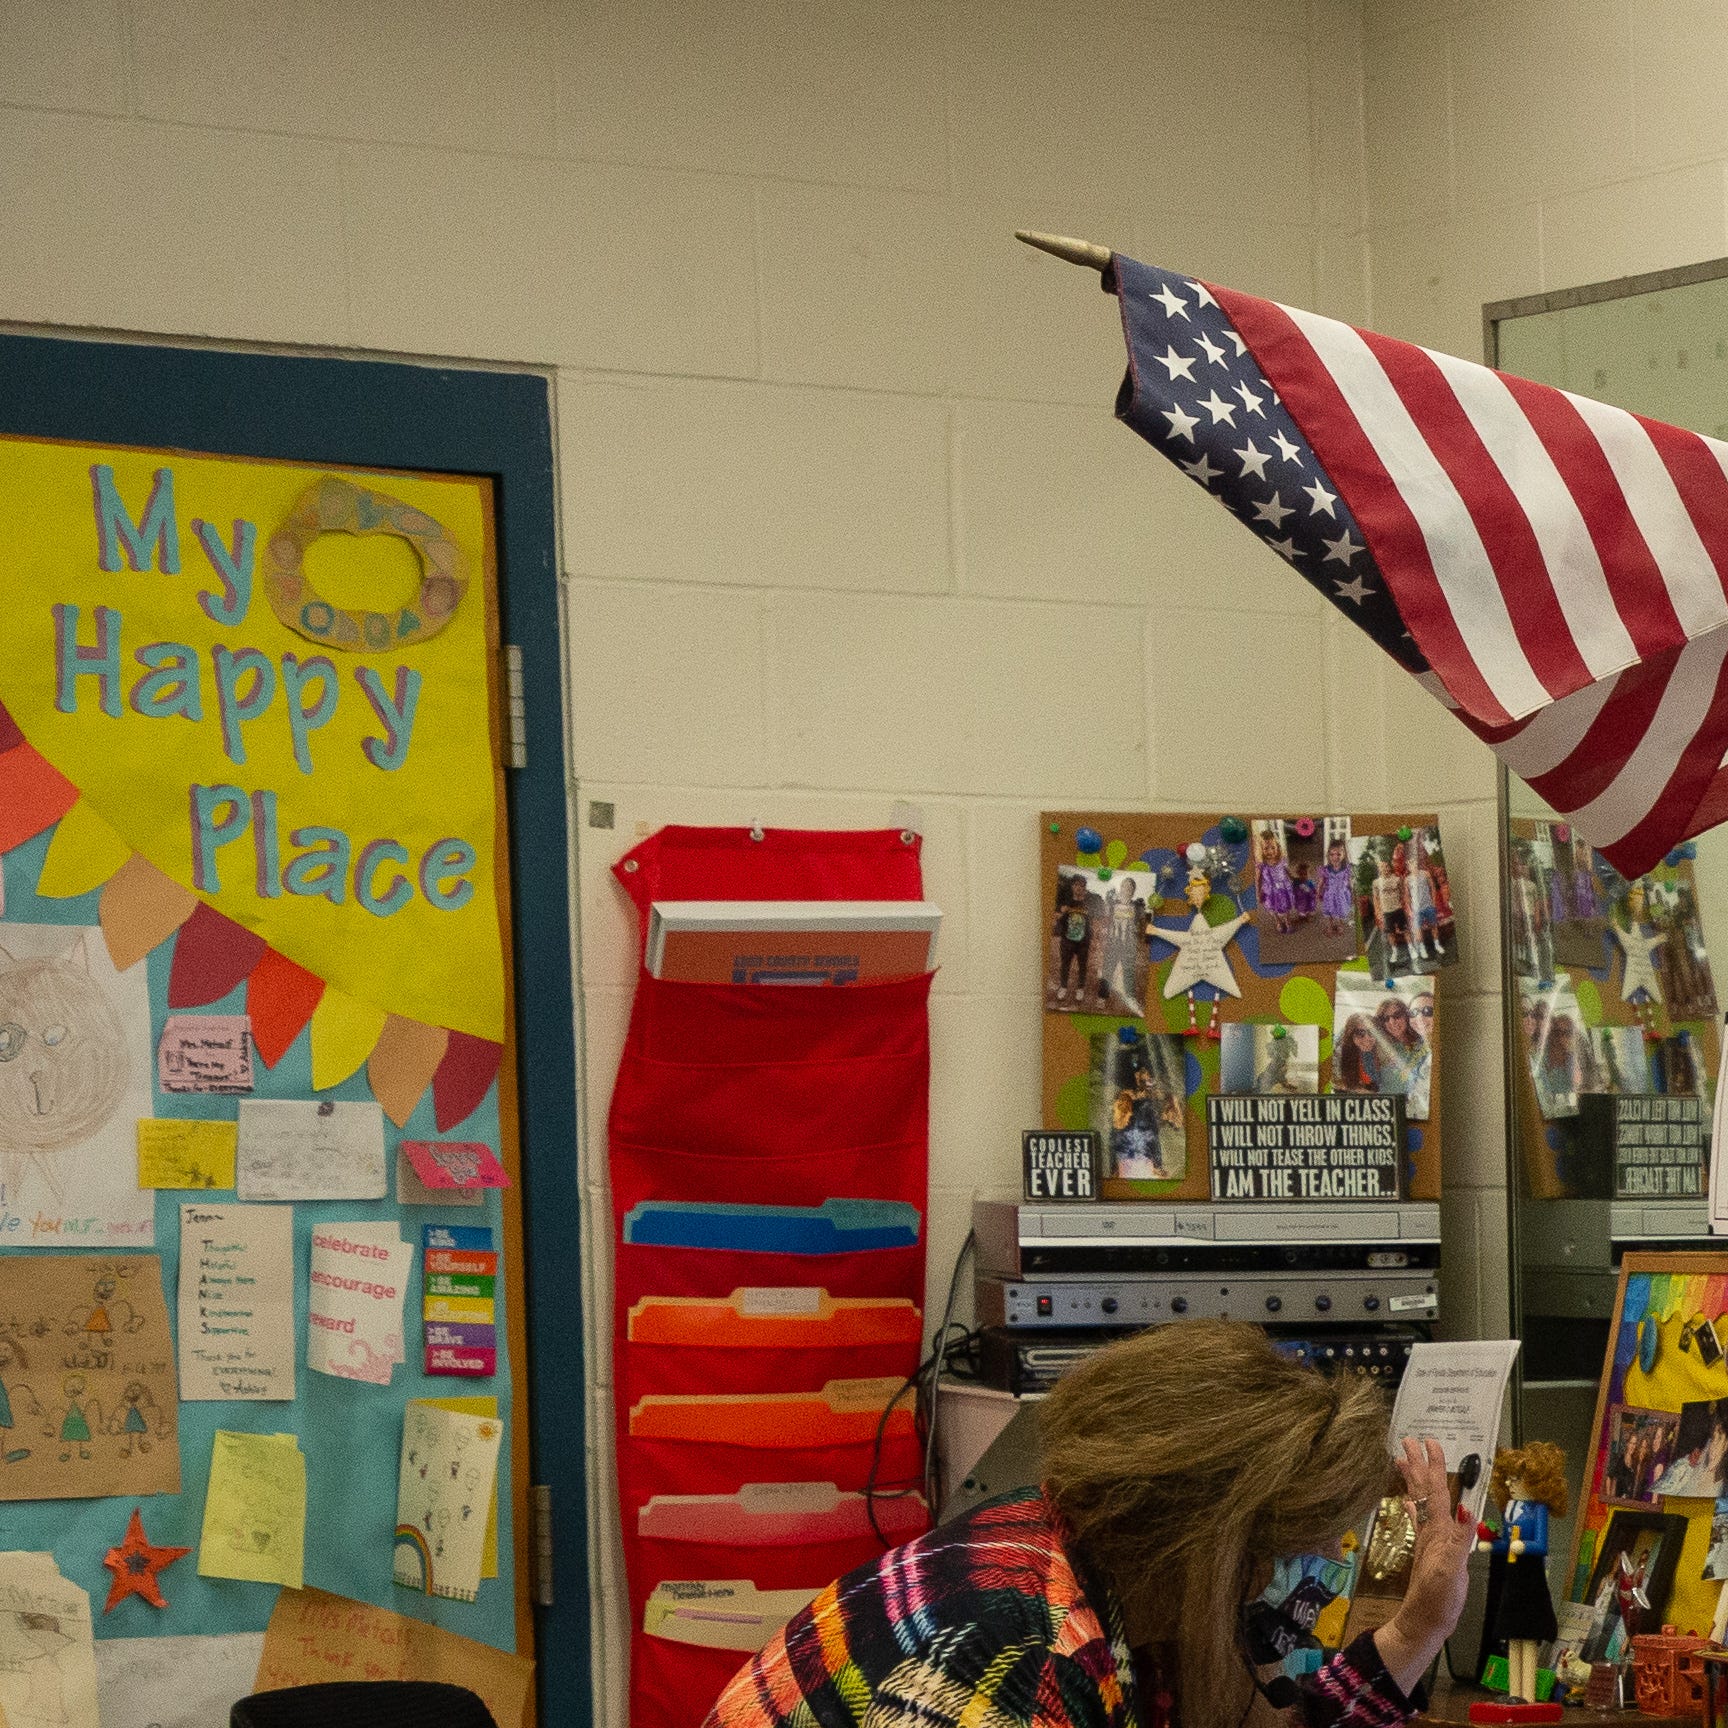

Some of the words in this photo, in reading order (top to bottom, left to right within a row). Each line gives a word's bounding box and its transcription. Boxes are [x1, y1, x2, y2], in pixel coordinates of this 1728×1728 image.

[90, 464, 258, 626] My
[53, 604, 422, 774] Happy
[189, 784, 477, 917] Place
[1210, 1100, 1219, 1121] I
[1222, 1100, 1253, 1121] WILL
[1257, 1100, 1283, 1121] NOT
[1287, 1100, 1321, 1121] YELL
[1326, 1100, 1341, 1121] IN
[1029, 1138, 1088, 1151] COOLEST
[1212, 1126, 1219, 1145] I
[1221, 1126, 1253, 1145] WILL
[1256, 1126, 1282, 1145] NOT
[1286, 1126, 1337, 1145] THROW
[1030, 1152, 1090, 1168] TEACHER
[1030, 1171, 1091, 1195] EVER
[1214, 1170, 1221, 1195] I
[1225, 1170, 1256, 1195] AM
[1259, 1170, 1294, 1195] THE
[1298, 1169, 1396, 1195] TEACHER...
